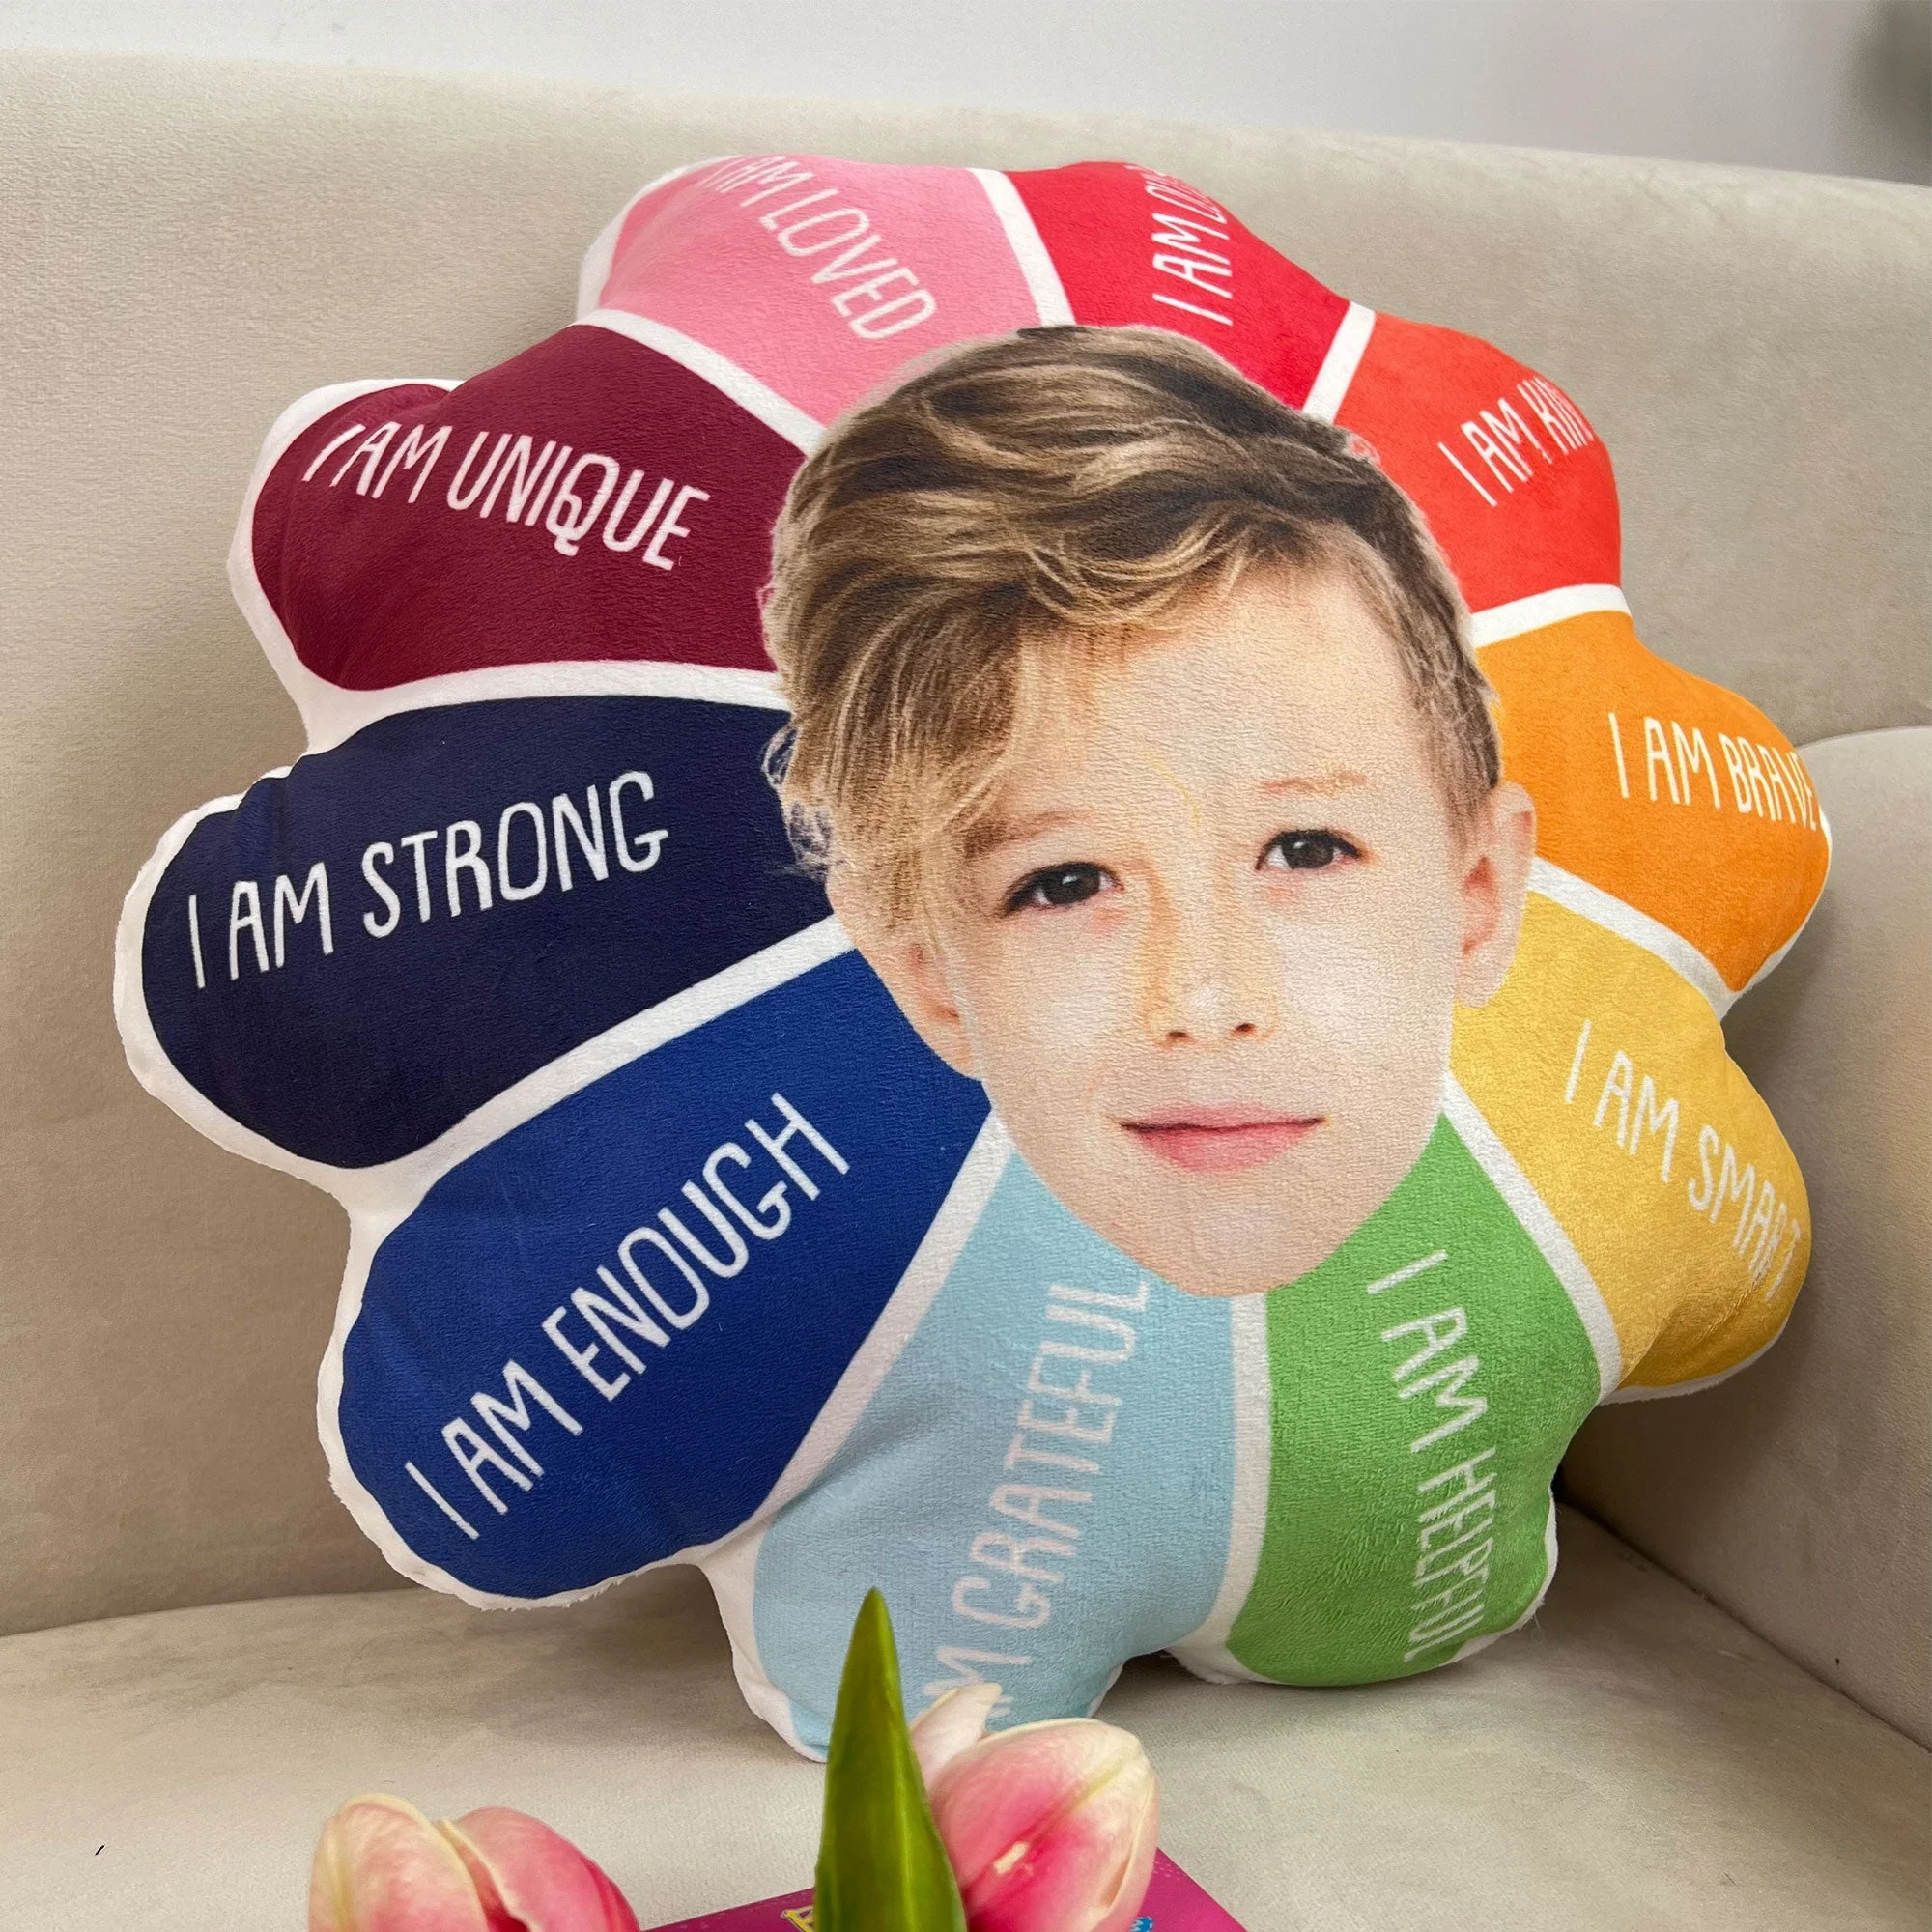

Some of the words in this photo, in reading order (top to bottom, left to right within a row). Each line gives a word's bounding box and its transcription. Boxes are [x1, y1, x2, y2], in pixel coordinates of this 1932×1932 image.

[758, 188, 937, 340] LOVED
[1151, 213, 1234, 299] AM
[1151, 293, 1234, 327] I
[302, 423, 367, 483] I
[329, 420, 454, 504] AM
[446, 430, 711, 572] UNIQUE
[1436, 440, 1498, 507] I
[1460, 397, 1553, 494] AM
[1607, 711, 1631, 800] I
[1644, 715, 1722, 810] AM
[1717, 731, 1817, 833] BRAVE
[188, 894, 206, 990] I
[229, 861, 335, 980] AM
[360, 770, 669, 939] STRONG
[1564, 1018, 1593, 1105] I
[1592, 1050, 1681, 1184] AM
[541, 1091, 851, 1403] ENOUGH
[1366, 1249, 1449, 1295] I
[440, 1358, 584, 1515] AM
[1380, 1306, 1489, 1454] AM
[404, 1461, 481, 1541] I
[951, 1279, 1151, 1631] GRATEFUL
